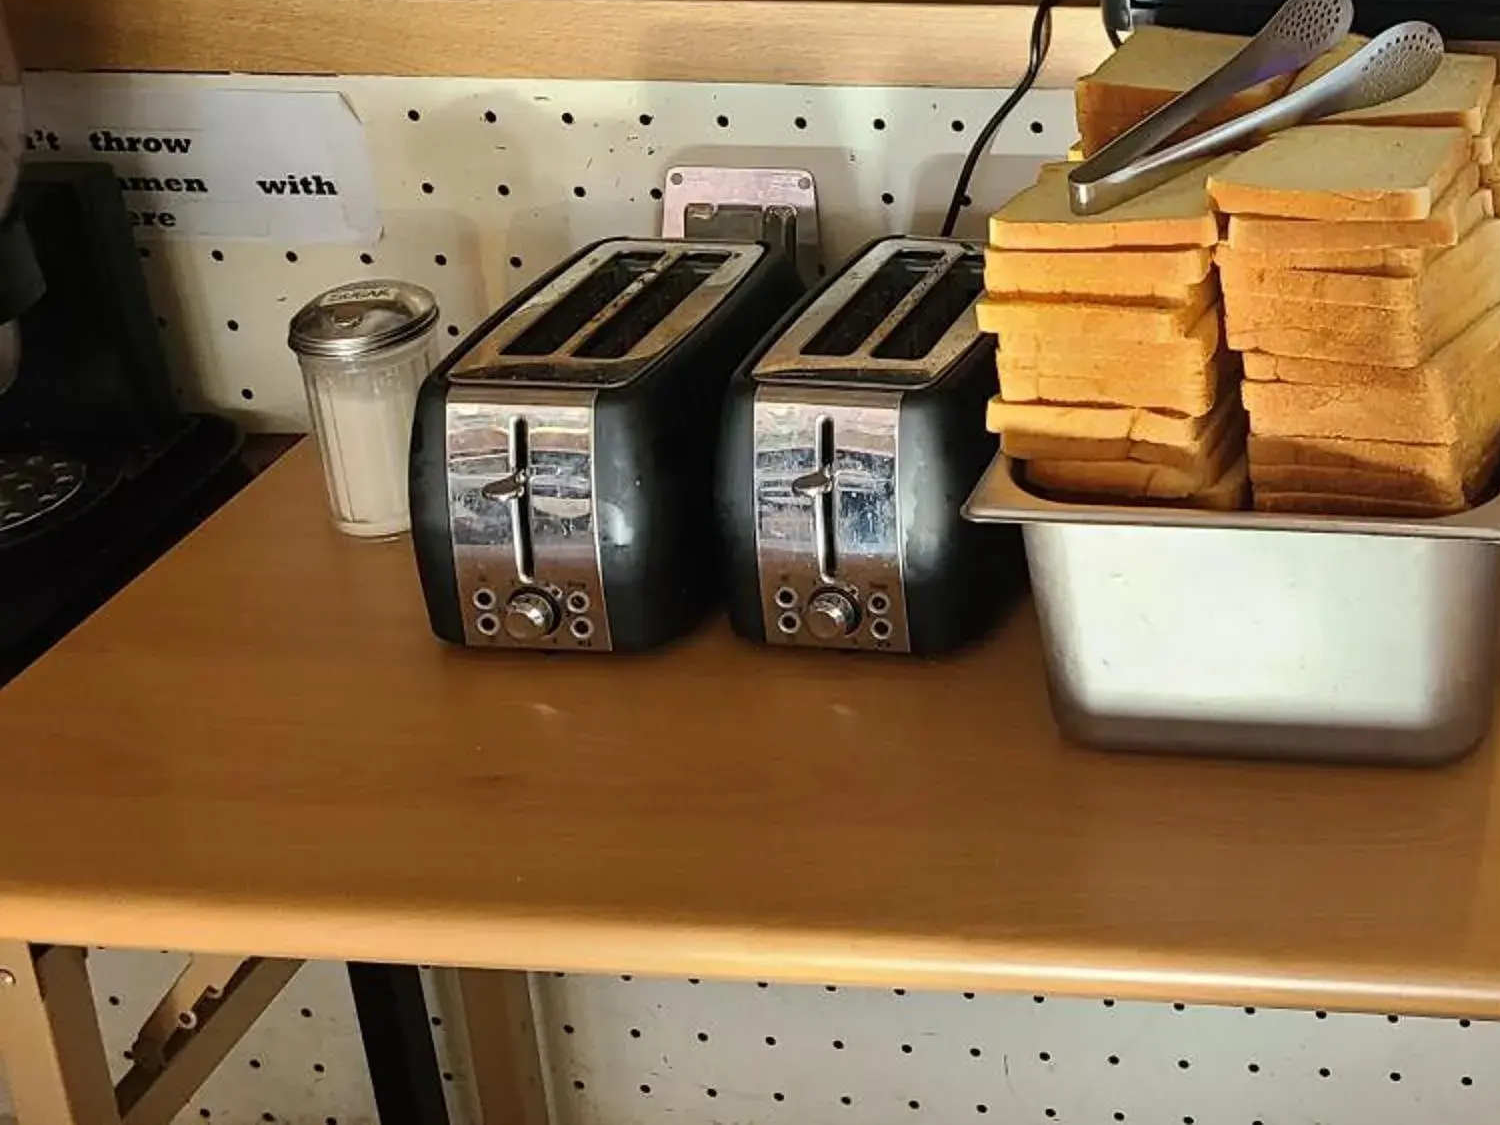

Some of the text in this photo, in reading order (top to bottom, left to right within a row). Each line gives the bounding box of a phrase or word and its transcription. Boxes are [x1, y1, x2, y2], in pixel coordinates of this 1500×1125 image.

[88, 130, 193, 154] throw
[256, 174, 339, 196] with
[126, 210, 177, 227] ere
